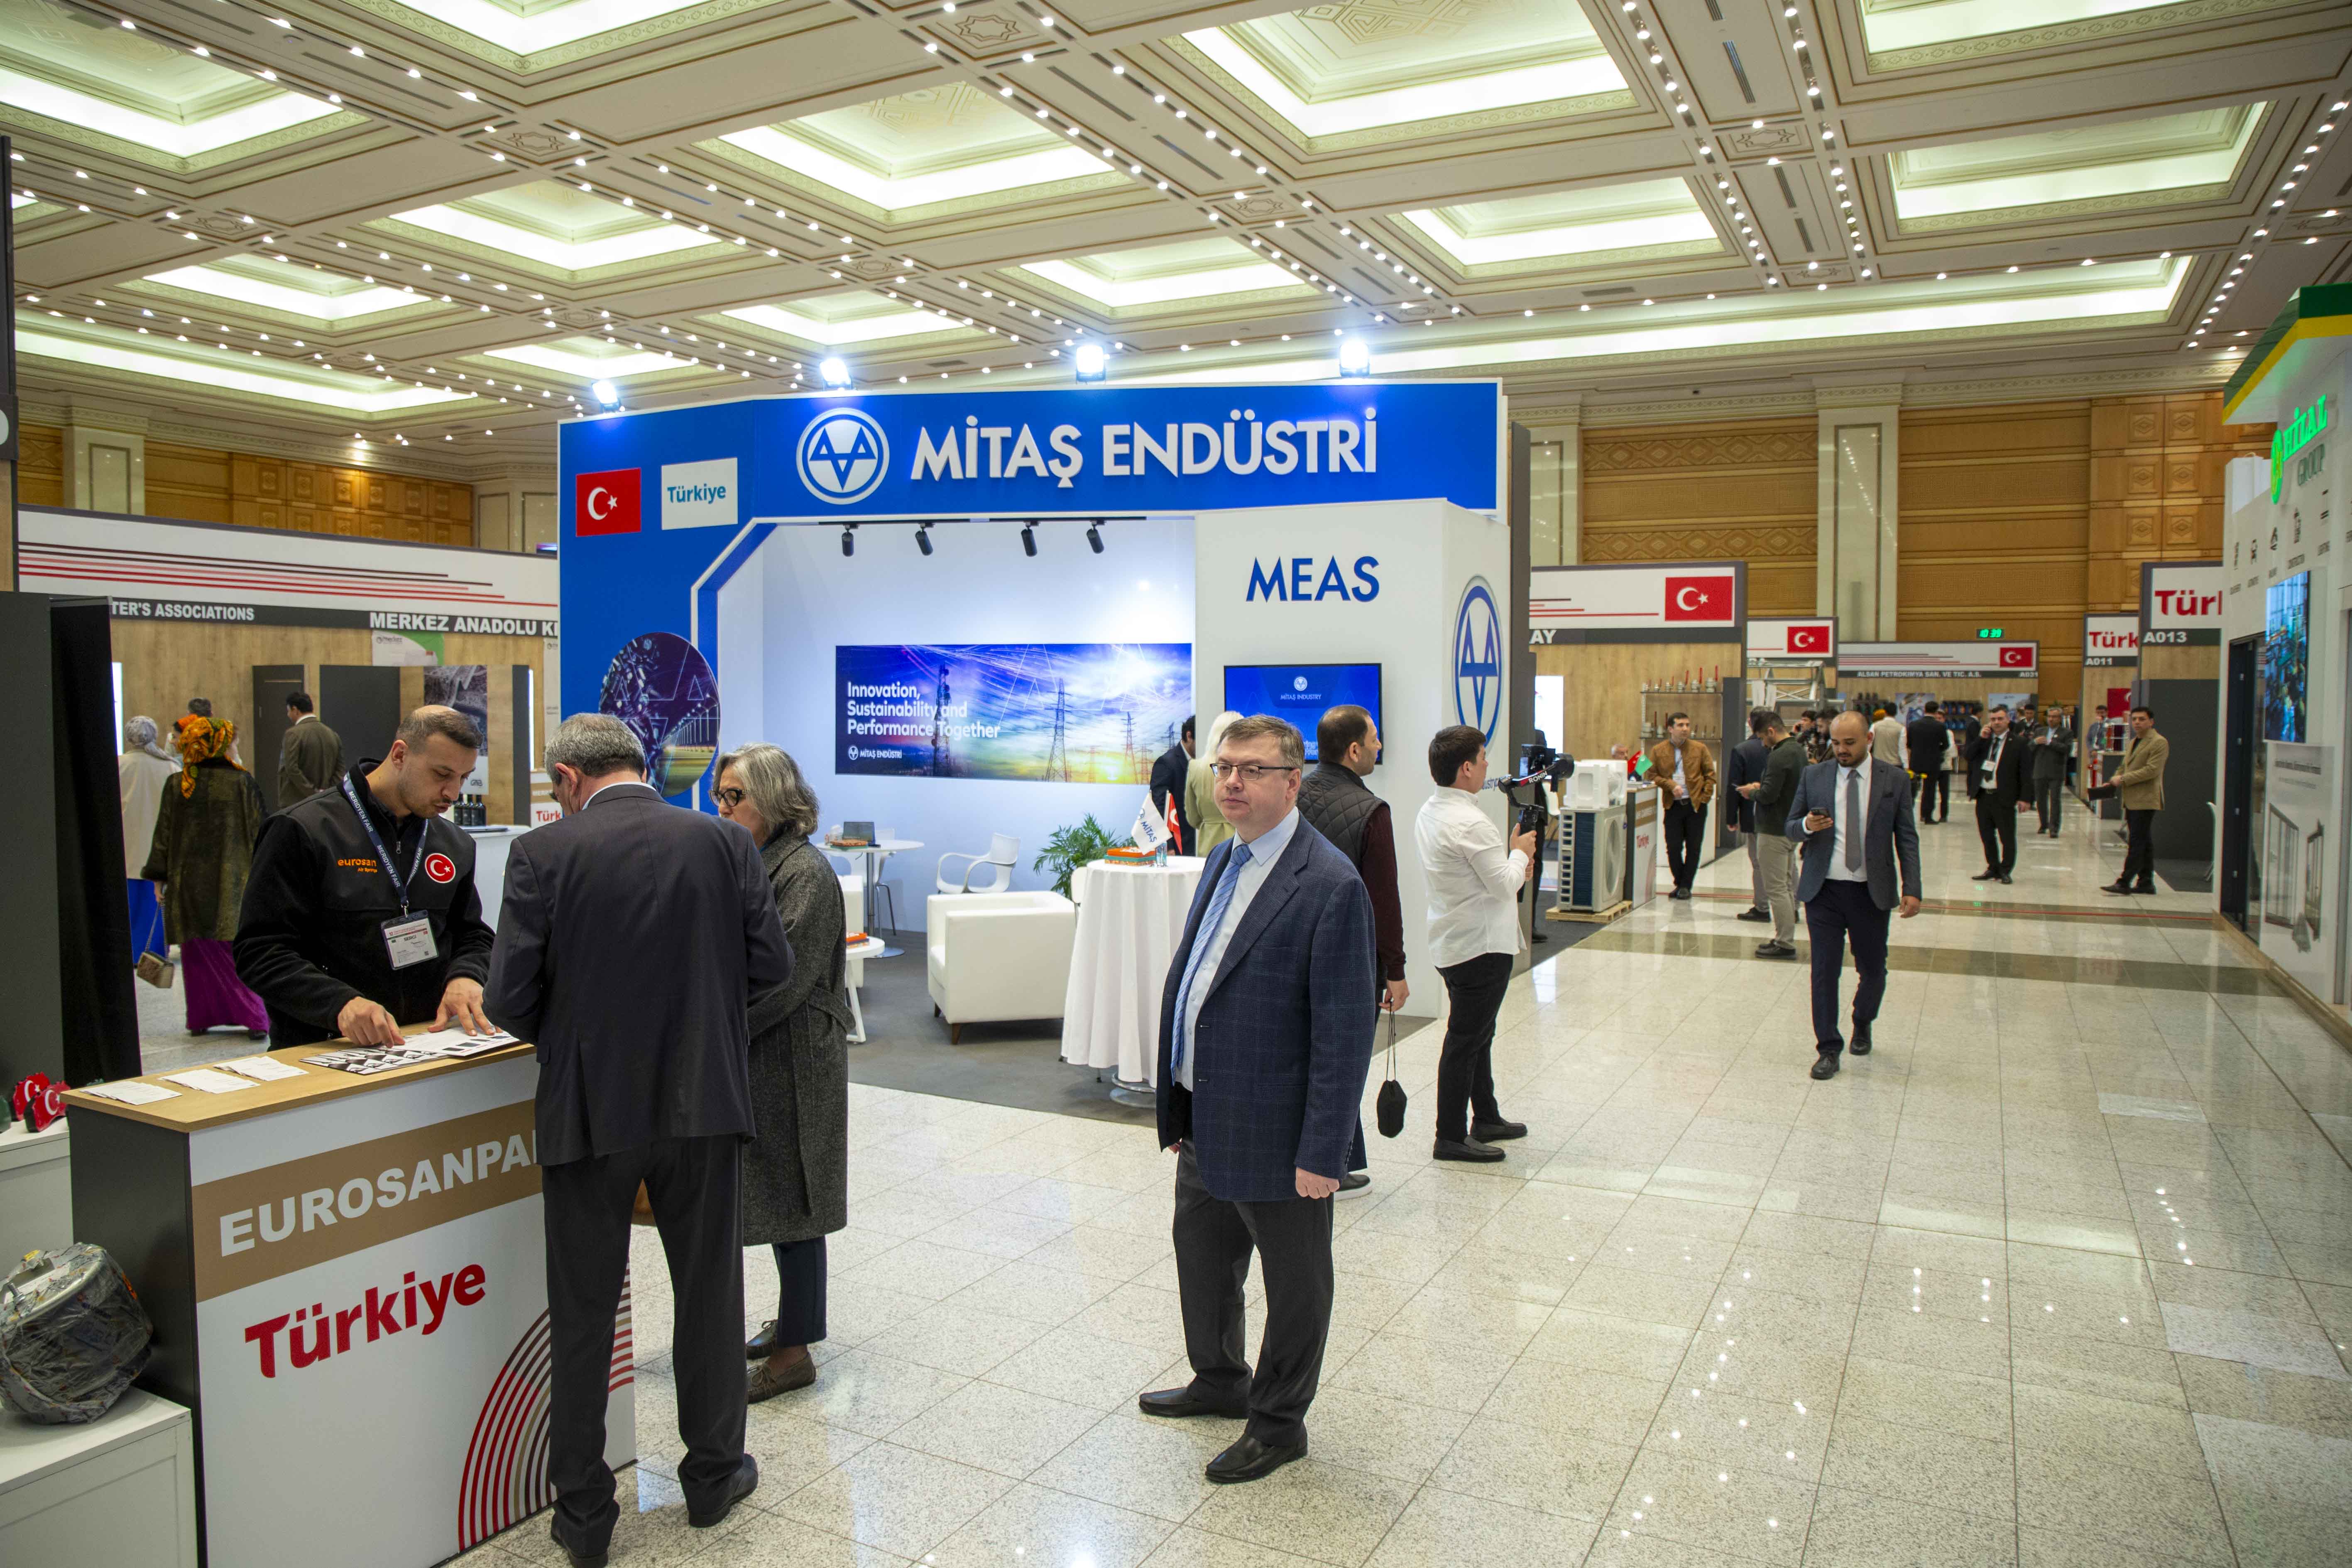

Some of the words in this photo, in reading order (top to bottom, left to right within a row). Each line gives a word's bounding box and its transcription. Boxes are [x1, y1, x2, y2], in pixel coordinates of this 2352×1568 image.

[910, 415, 1083, 488] MİTAŞ
[1103, 408, 1377, 477] ENDÜSTRİ
[667, 483, 726, 504] Türkiye
[1246, 555, 1380, 602] MEAS
[155, 603, 255, 621] ASSOCIATIONS
[370, 612, 449, 631] MERKEZ
[454, 617, 537, 635] ANADOLU
[2143, 631, 2187, 643] A013
[2085, 658, 2112, 666] A011
[847, 681, 920, 700] Innovation,
[847, 700, 937, 720] Sustainability
[941, 701, 968, 718] and
[847, 719, 933, 736] Performance
[937, 721, 1001, 740] Together
[859, 749, 876, 759] MİTAŞ
[876, 749, 902, 759] ENDÜSTRİ
[1528, 771, 1548, 784] RONIN
[348, 791, 366, 819] MERIDYEN
[362, 818, 374, 832] FAIR
[338, 859, 377, 867] eurosan
[377, 845, 394, 874] MERIDYEN
[391, 871, 401, 888] FAIR
[220, 1130, 536, 1257] EUROSANPA
[244, 1264, 486, 1378] Türkiye
